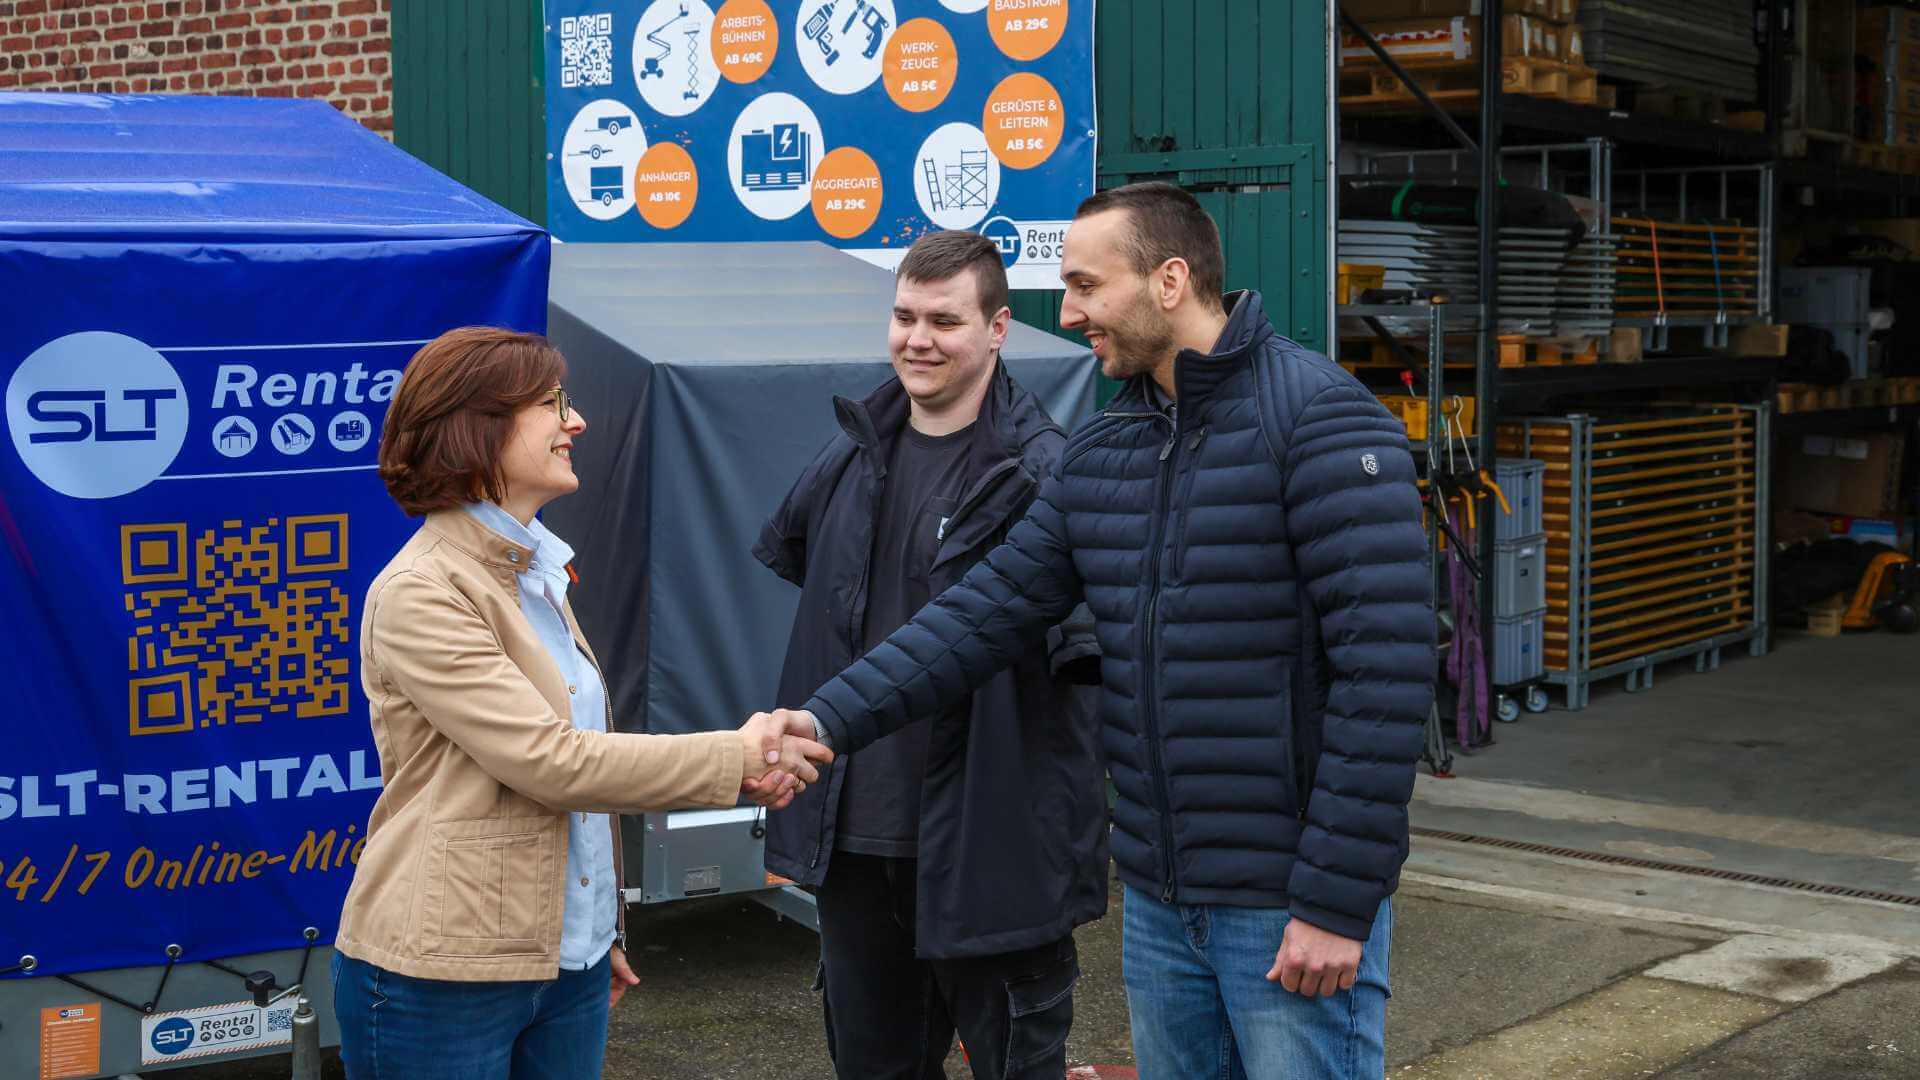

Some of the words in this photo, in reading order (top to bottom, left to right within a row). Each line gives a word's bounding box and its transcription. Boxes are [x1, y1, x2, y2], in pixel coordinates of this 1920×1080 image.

[995, 0, 1061, 11] BAUSTROM
[720, 15, 766, 29] ARBEITS-
[1004, 19, 1023, 32] AB
[1024, 18, 1048, 30] 29€
[721, 30, 766, 44] BÜHNEN
[901, 41, 939, 54] WERK-
[724, 54, 740, 65] AB
[741, 52, 762, 64] 49€
[901, 57, 939, 71] ZEUGE
[902, 81, 919, 93] AB
[920, 80, 937, 92] 5€
[991, 99, 1045, 113] GERÜSTE
[1047, 99, 1057, 112] &
[999, 116, 1049, 129] LEITERN
[1006, 139, 1025, 151] AB
[1026, 138, 1044, 150] 5€
[639, 170, 690, 183] ANHÄNGER
[815, 177, 879, 190] AGGREGATE
[649, 192, 664, 202] AB
[825, 200, 843, 210] AB
[844, 198, 866, 209] 29€
[26, 388, 177, 444] SLT
[0, 844, 111, 903] 4/7
[156, 1027, 193, 1045] SLT
[200, 1013, 255, 1031] Rental
